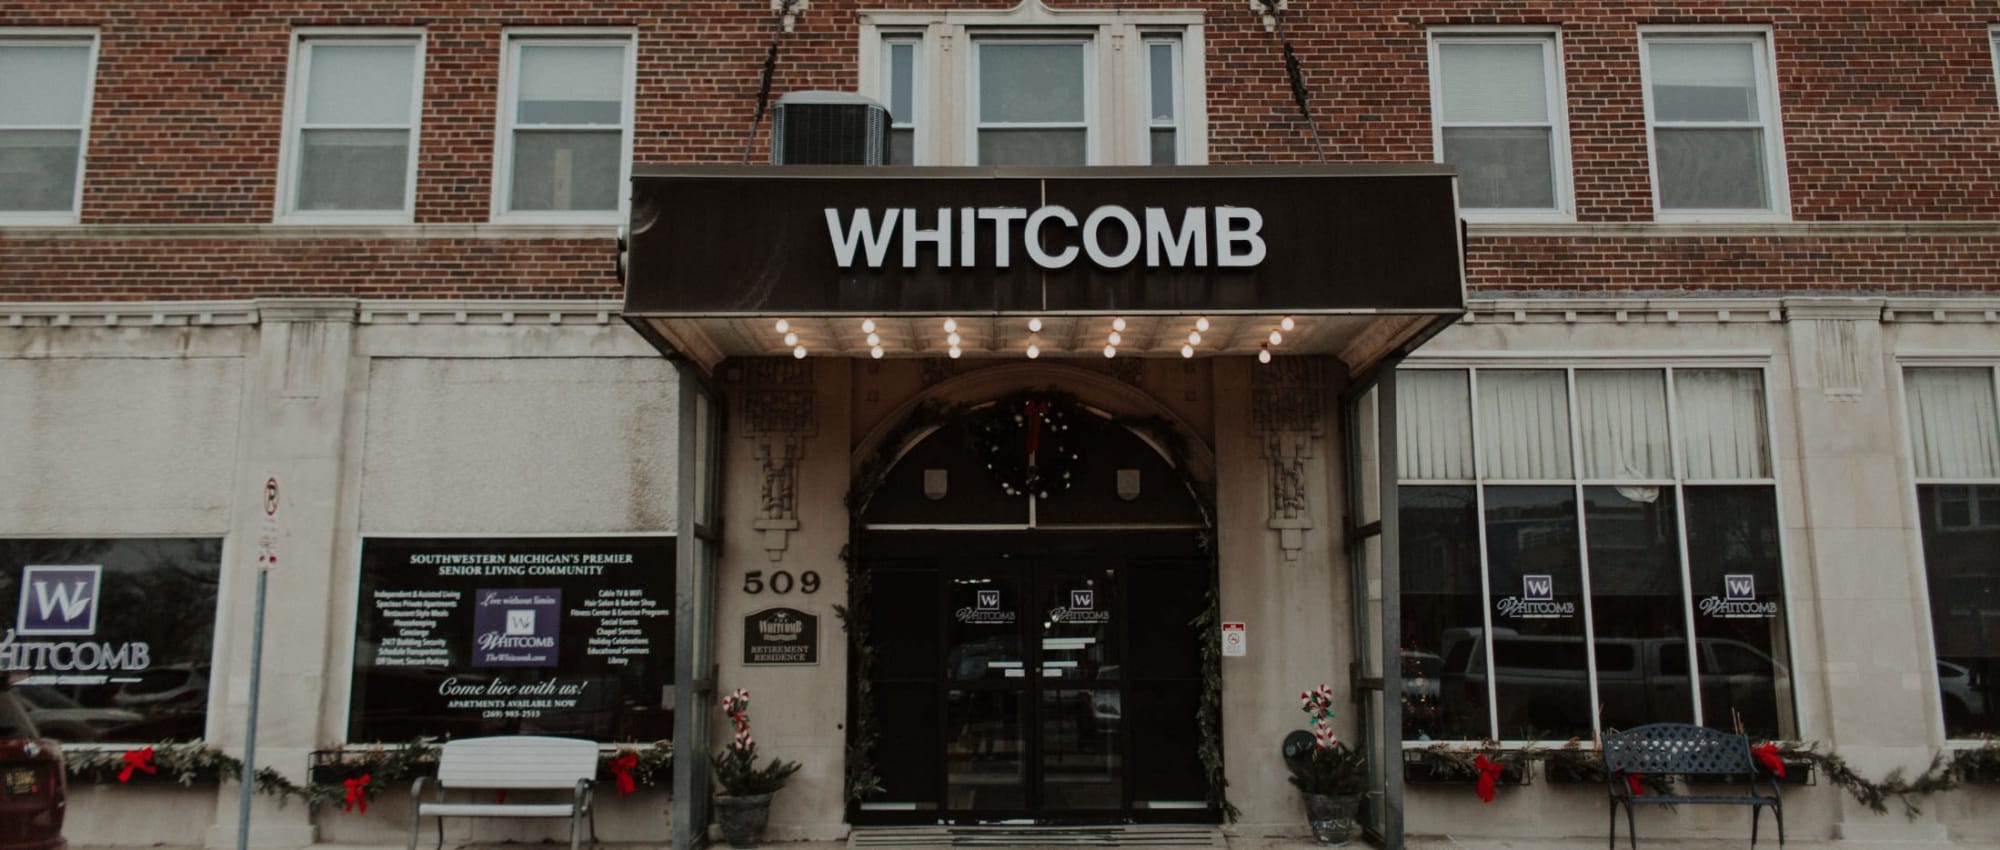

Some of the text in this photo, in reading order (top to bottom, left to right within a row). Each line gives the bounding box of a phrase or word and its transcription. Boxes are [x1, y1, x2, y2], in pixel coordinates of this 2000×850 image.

[824, 205, 1266, 269] WHITCOMB
[410, 554, 633, 565] SOUTHWESTERN MICHIGAN'S PREMIER
[438, 565, 604, 576] SENIOR LIVING COMMUNITY
[743, 570, 820, 594] 509
[955, 607, 1016, 623] WHITCOMB
[1497, 598, 1575, 616] WHITCOMB
[1699, 598, 1777, 616] WHITCOMB
[0, 629, 151, 670] HITCOMB
[478, 632, 554, 650] WHITCOMB
[438, 677, 588, 696] Come live with us!
[448, 700, 577, 708] APARTMENTS AVAILABLE NOW
